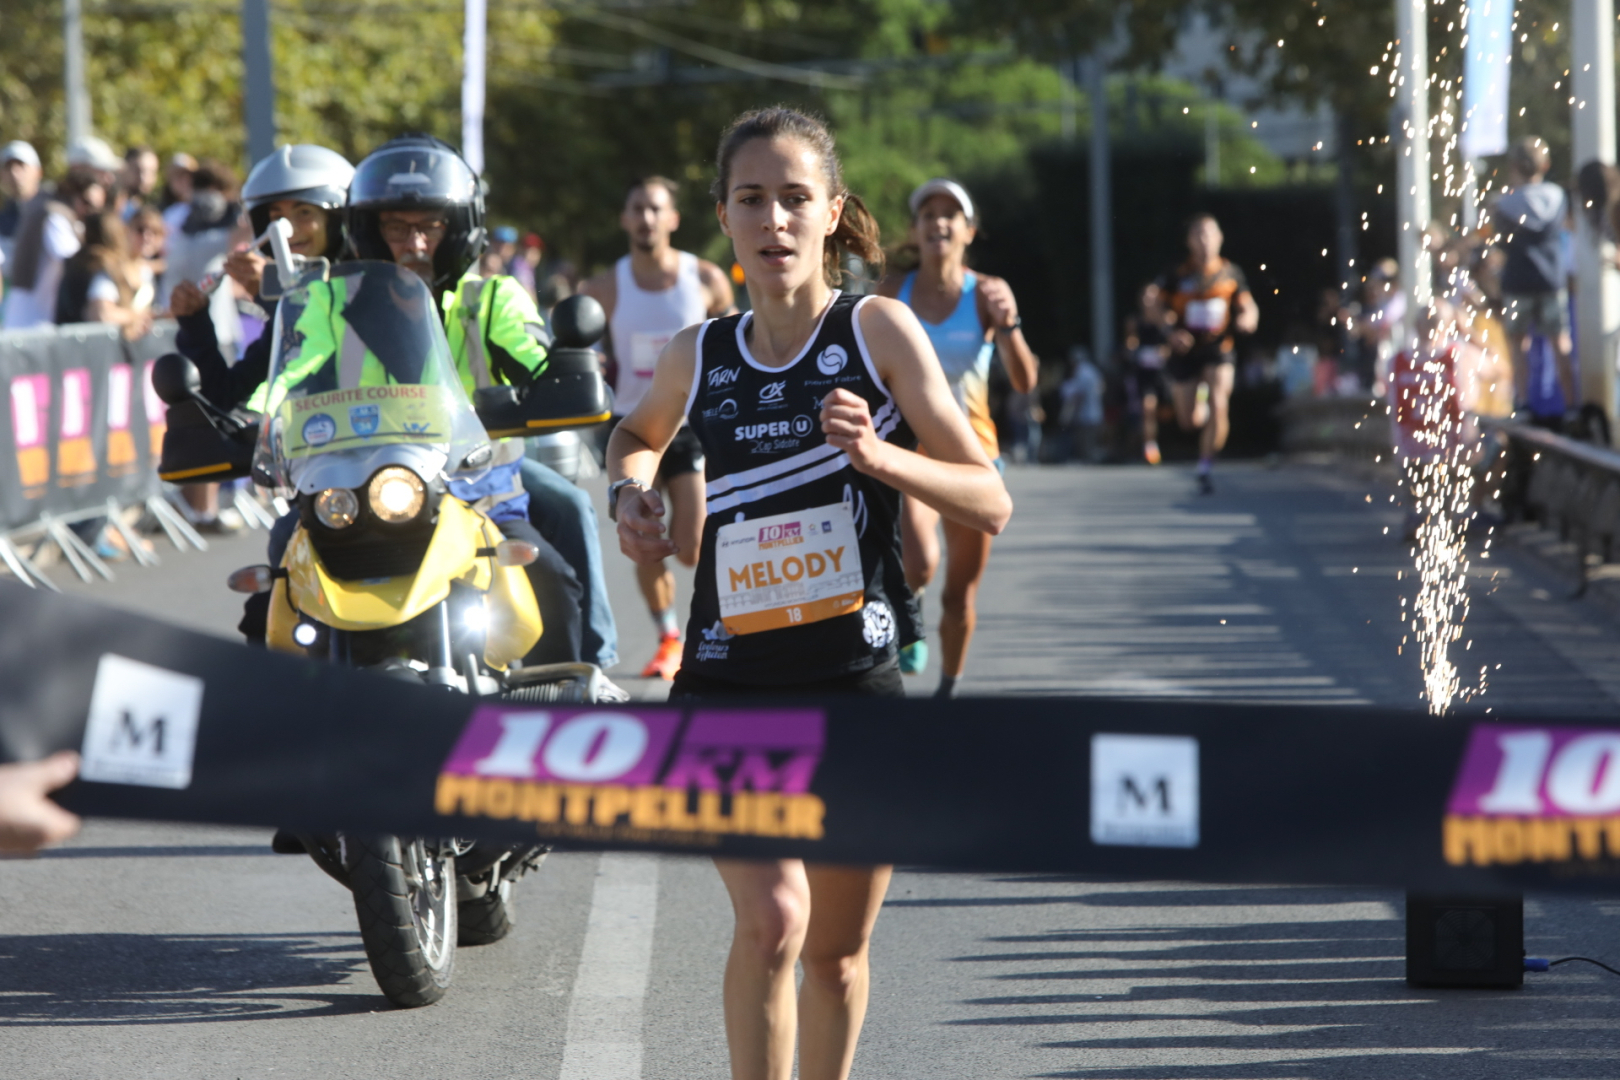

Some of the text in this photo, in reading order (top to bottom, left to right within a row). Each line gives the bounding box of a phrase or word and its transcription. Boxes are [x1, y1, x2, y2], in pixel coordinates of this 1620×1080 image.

[707, 365, 741, 387] TARN
[367, 386, 427, 399] COURSE
[735, 420, 790, 441] SUPER
[761, 526, 781, 541] 10
[728, 546, 845, 592] MELODY
[786, 607, 802, 623] 18
[474, 710, 649, 782] 10
[434, 773, 826, 840] MONTPELLIER
